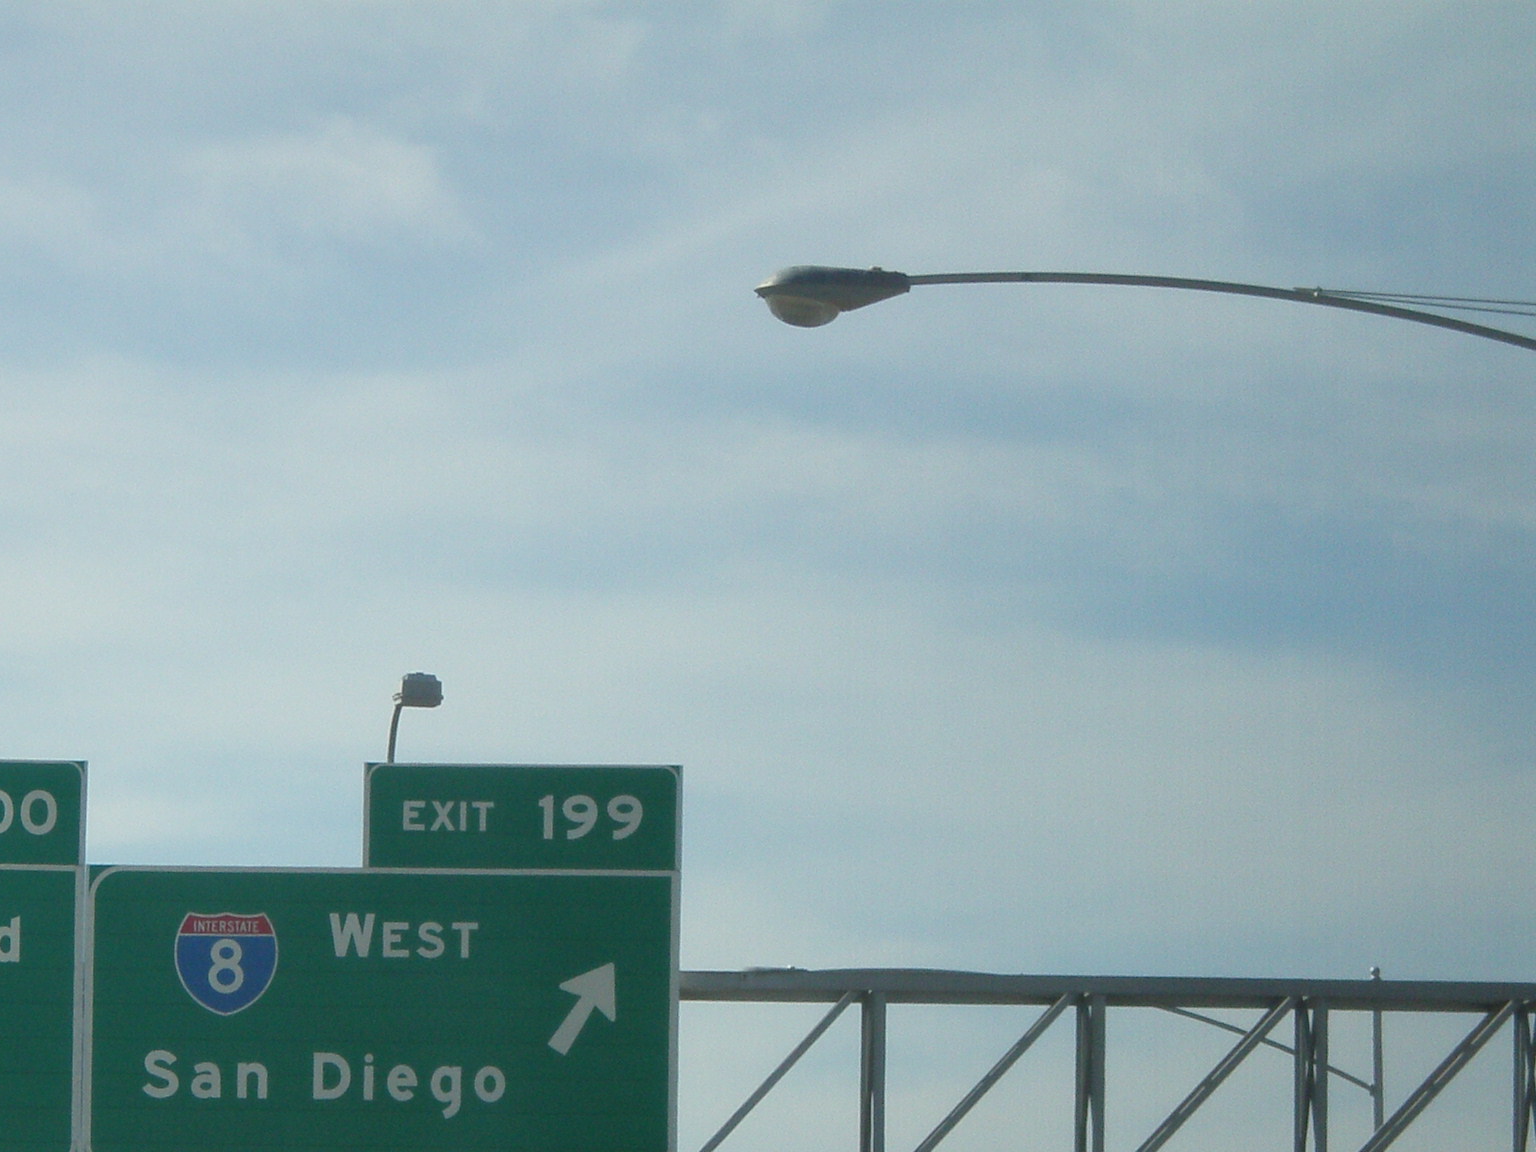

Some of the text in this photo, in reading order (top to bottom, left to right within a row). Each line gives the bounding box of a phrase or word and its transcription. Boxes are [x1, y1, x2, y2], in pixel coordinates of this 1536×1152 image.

[402, 794, 644, 840] EXIT 199
[192, 920, 261, 934] INTERSTATE
[329, 911, 479, 959] WEST
[208, 938, 244, 994] 8
[142, 1049, 506, 1119] San Diego
